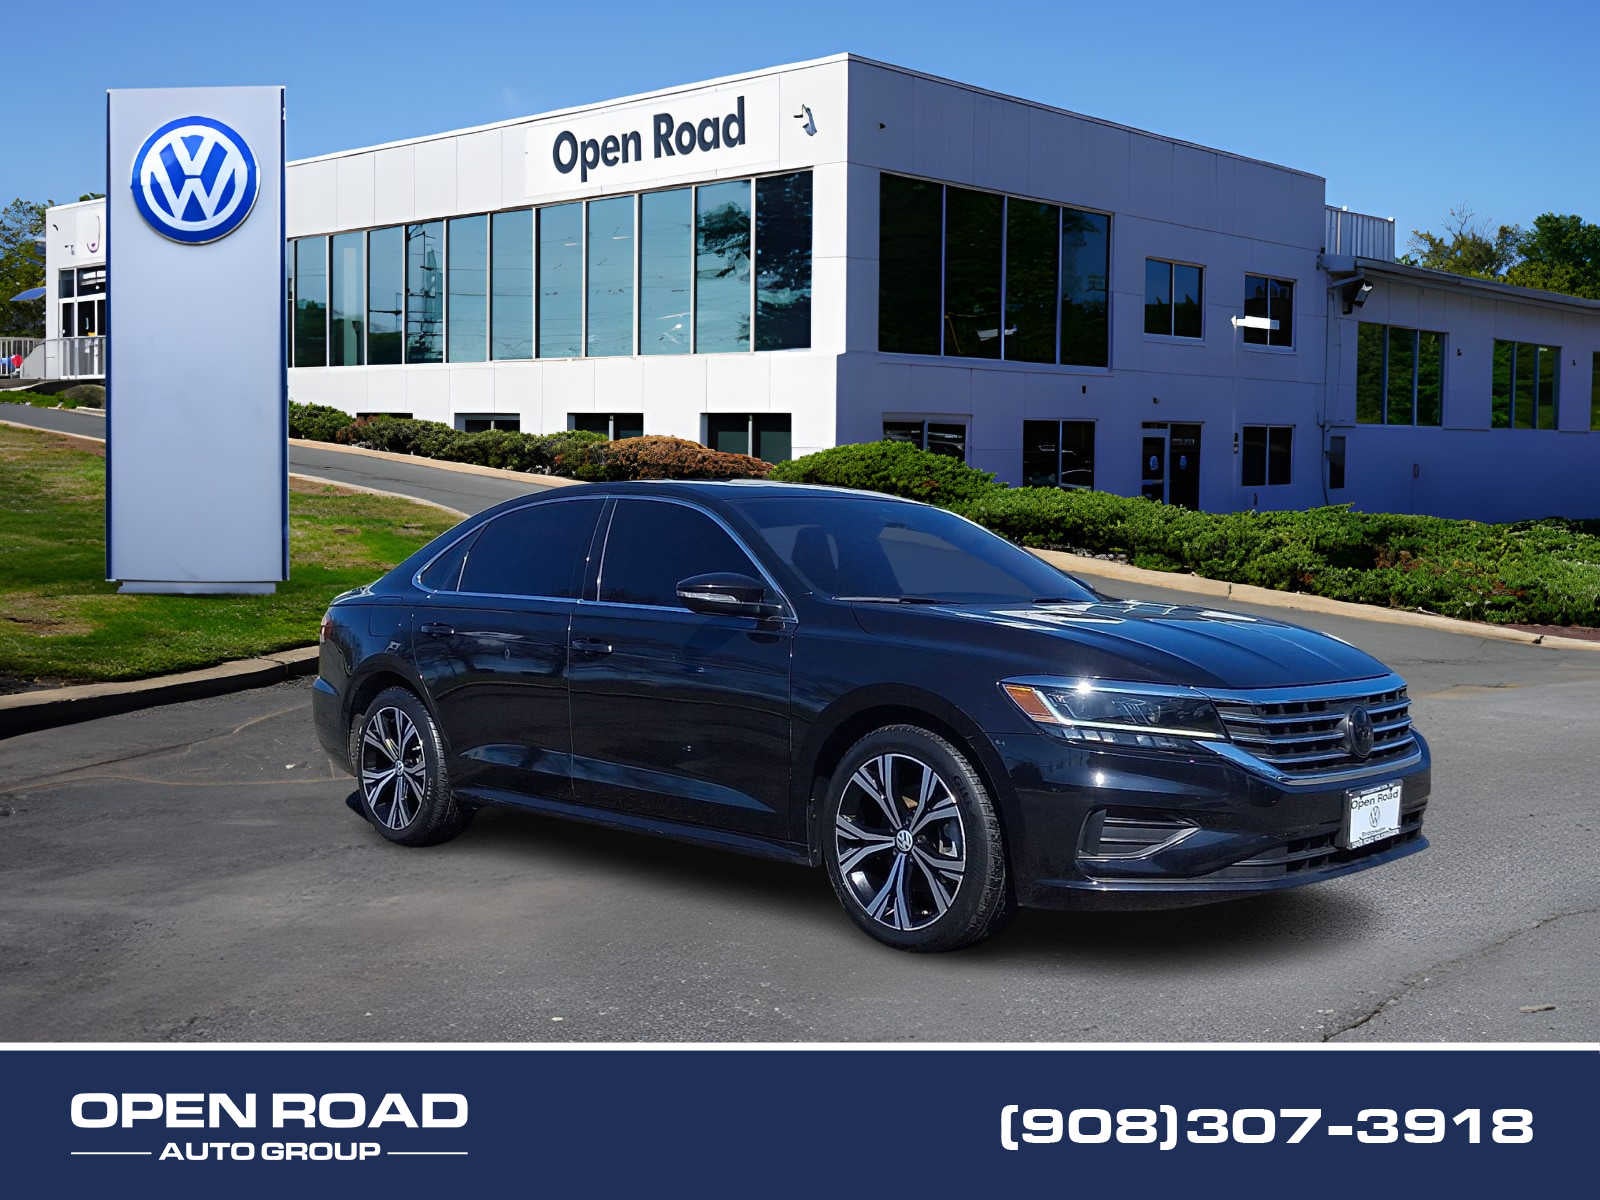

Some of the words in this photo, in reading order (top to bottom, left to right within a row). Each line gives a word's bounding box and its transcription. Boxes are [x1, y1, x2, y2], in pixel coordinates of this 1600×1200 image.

[138, 122, 250, 233] VW
[552, 129, 642, 182] Open
[652, 95, 746, 159] Road
[1350, 797, 1376, 811] Open
[1377, 789, 1399, 803] Road
